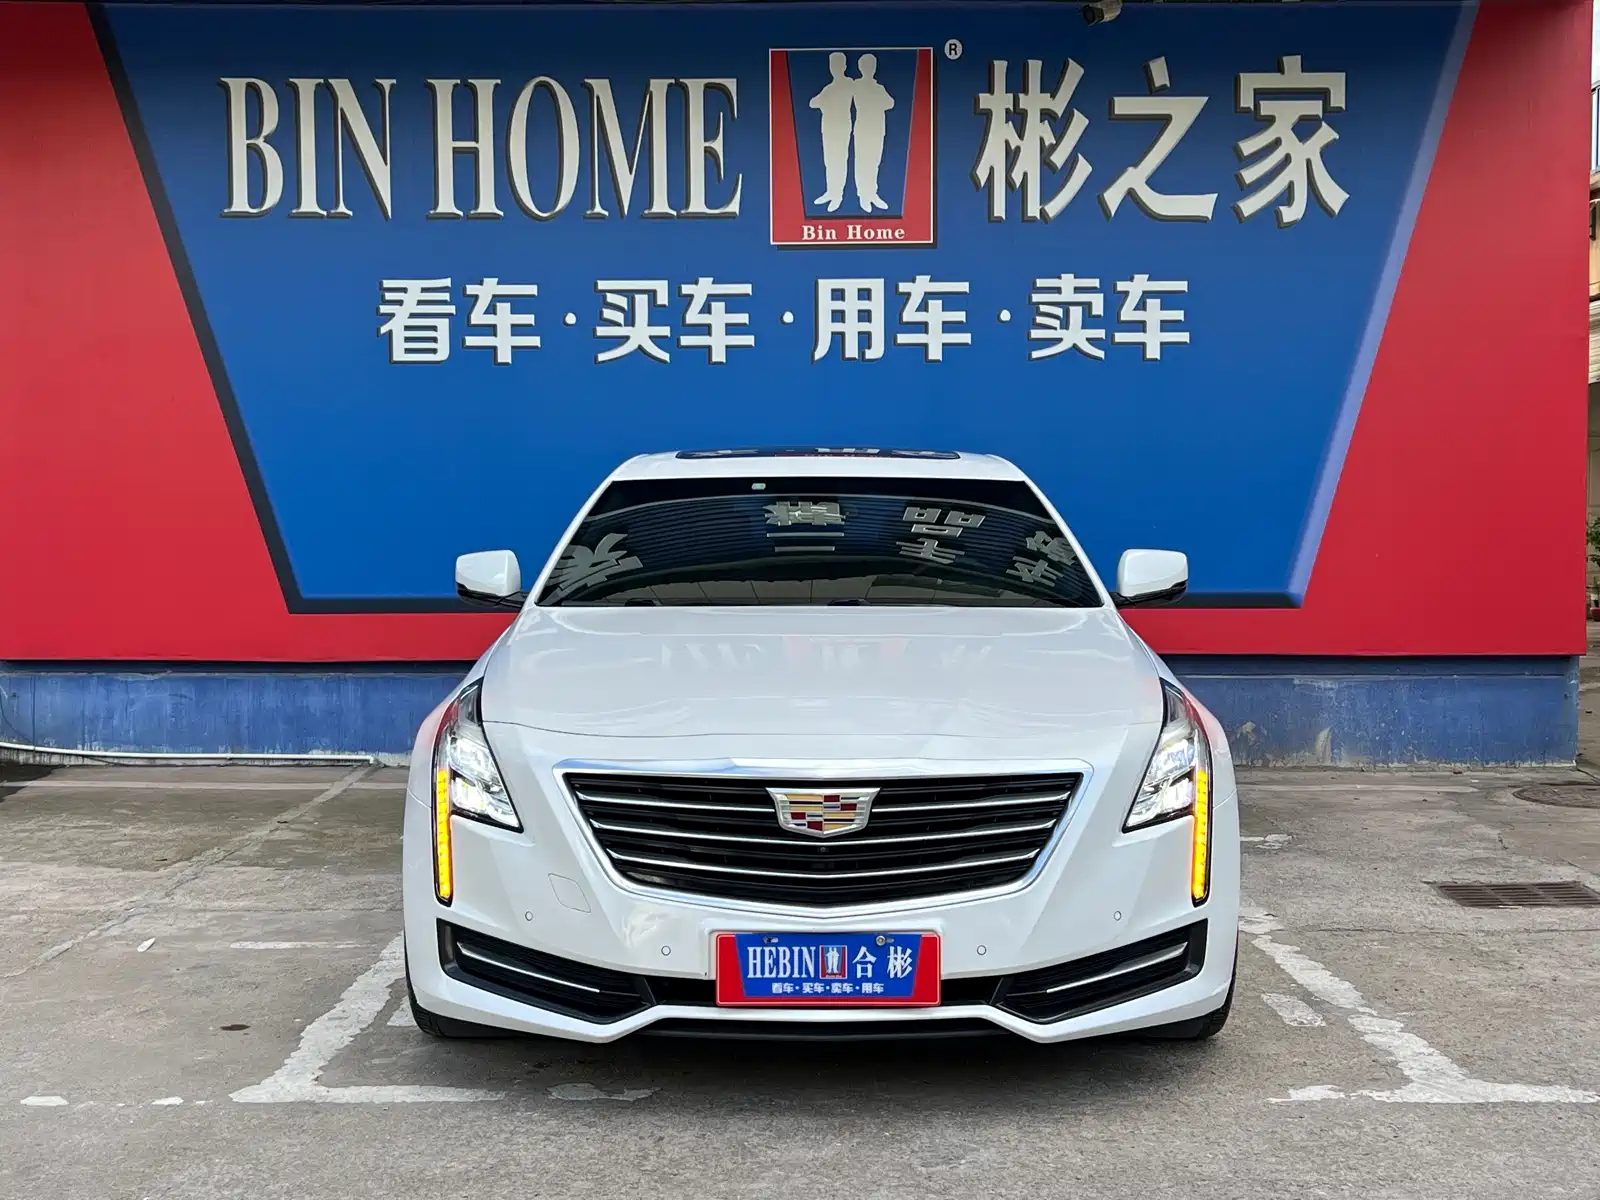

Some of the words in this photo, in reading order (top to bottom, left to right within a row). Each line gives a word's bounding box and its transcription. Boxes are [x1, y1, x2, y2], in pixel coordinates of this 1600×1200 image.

[218, 76, 397, 220] BIN
[425, 75, 743, 220] HOME
[970, 55, 1350, 227] 彬之家
[801, 224, 838, 241] Bin
[846, 224, 906, 241] Home
[747, 946, 816, 979] HEBIN
[852, 946, 913, 979] 合彬
